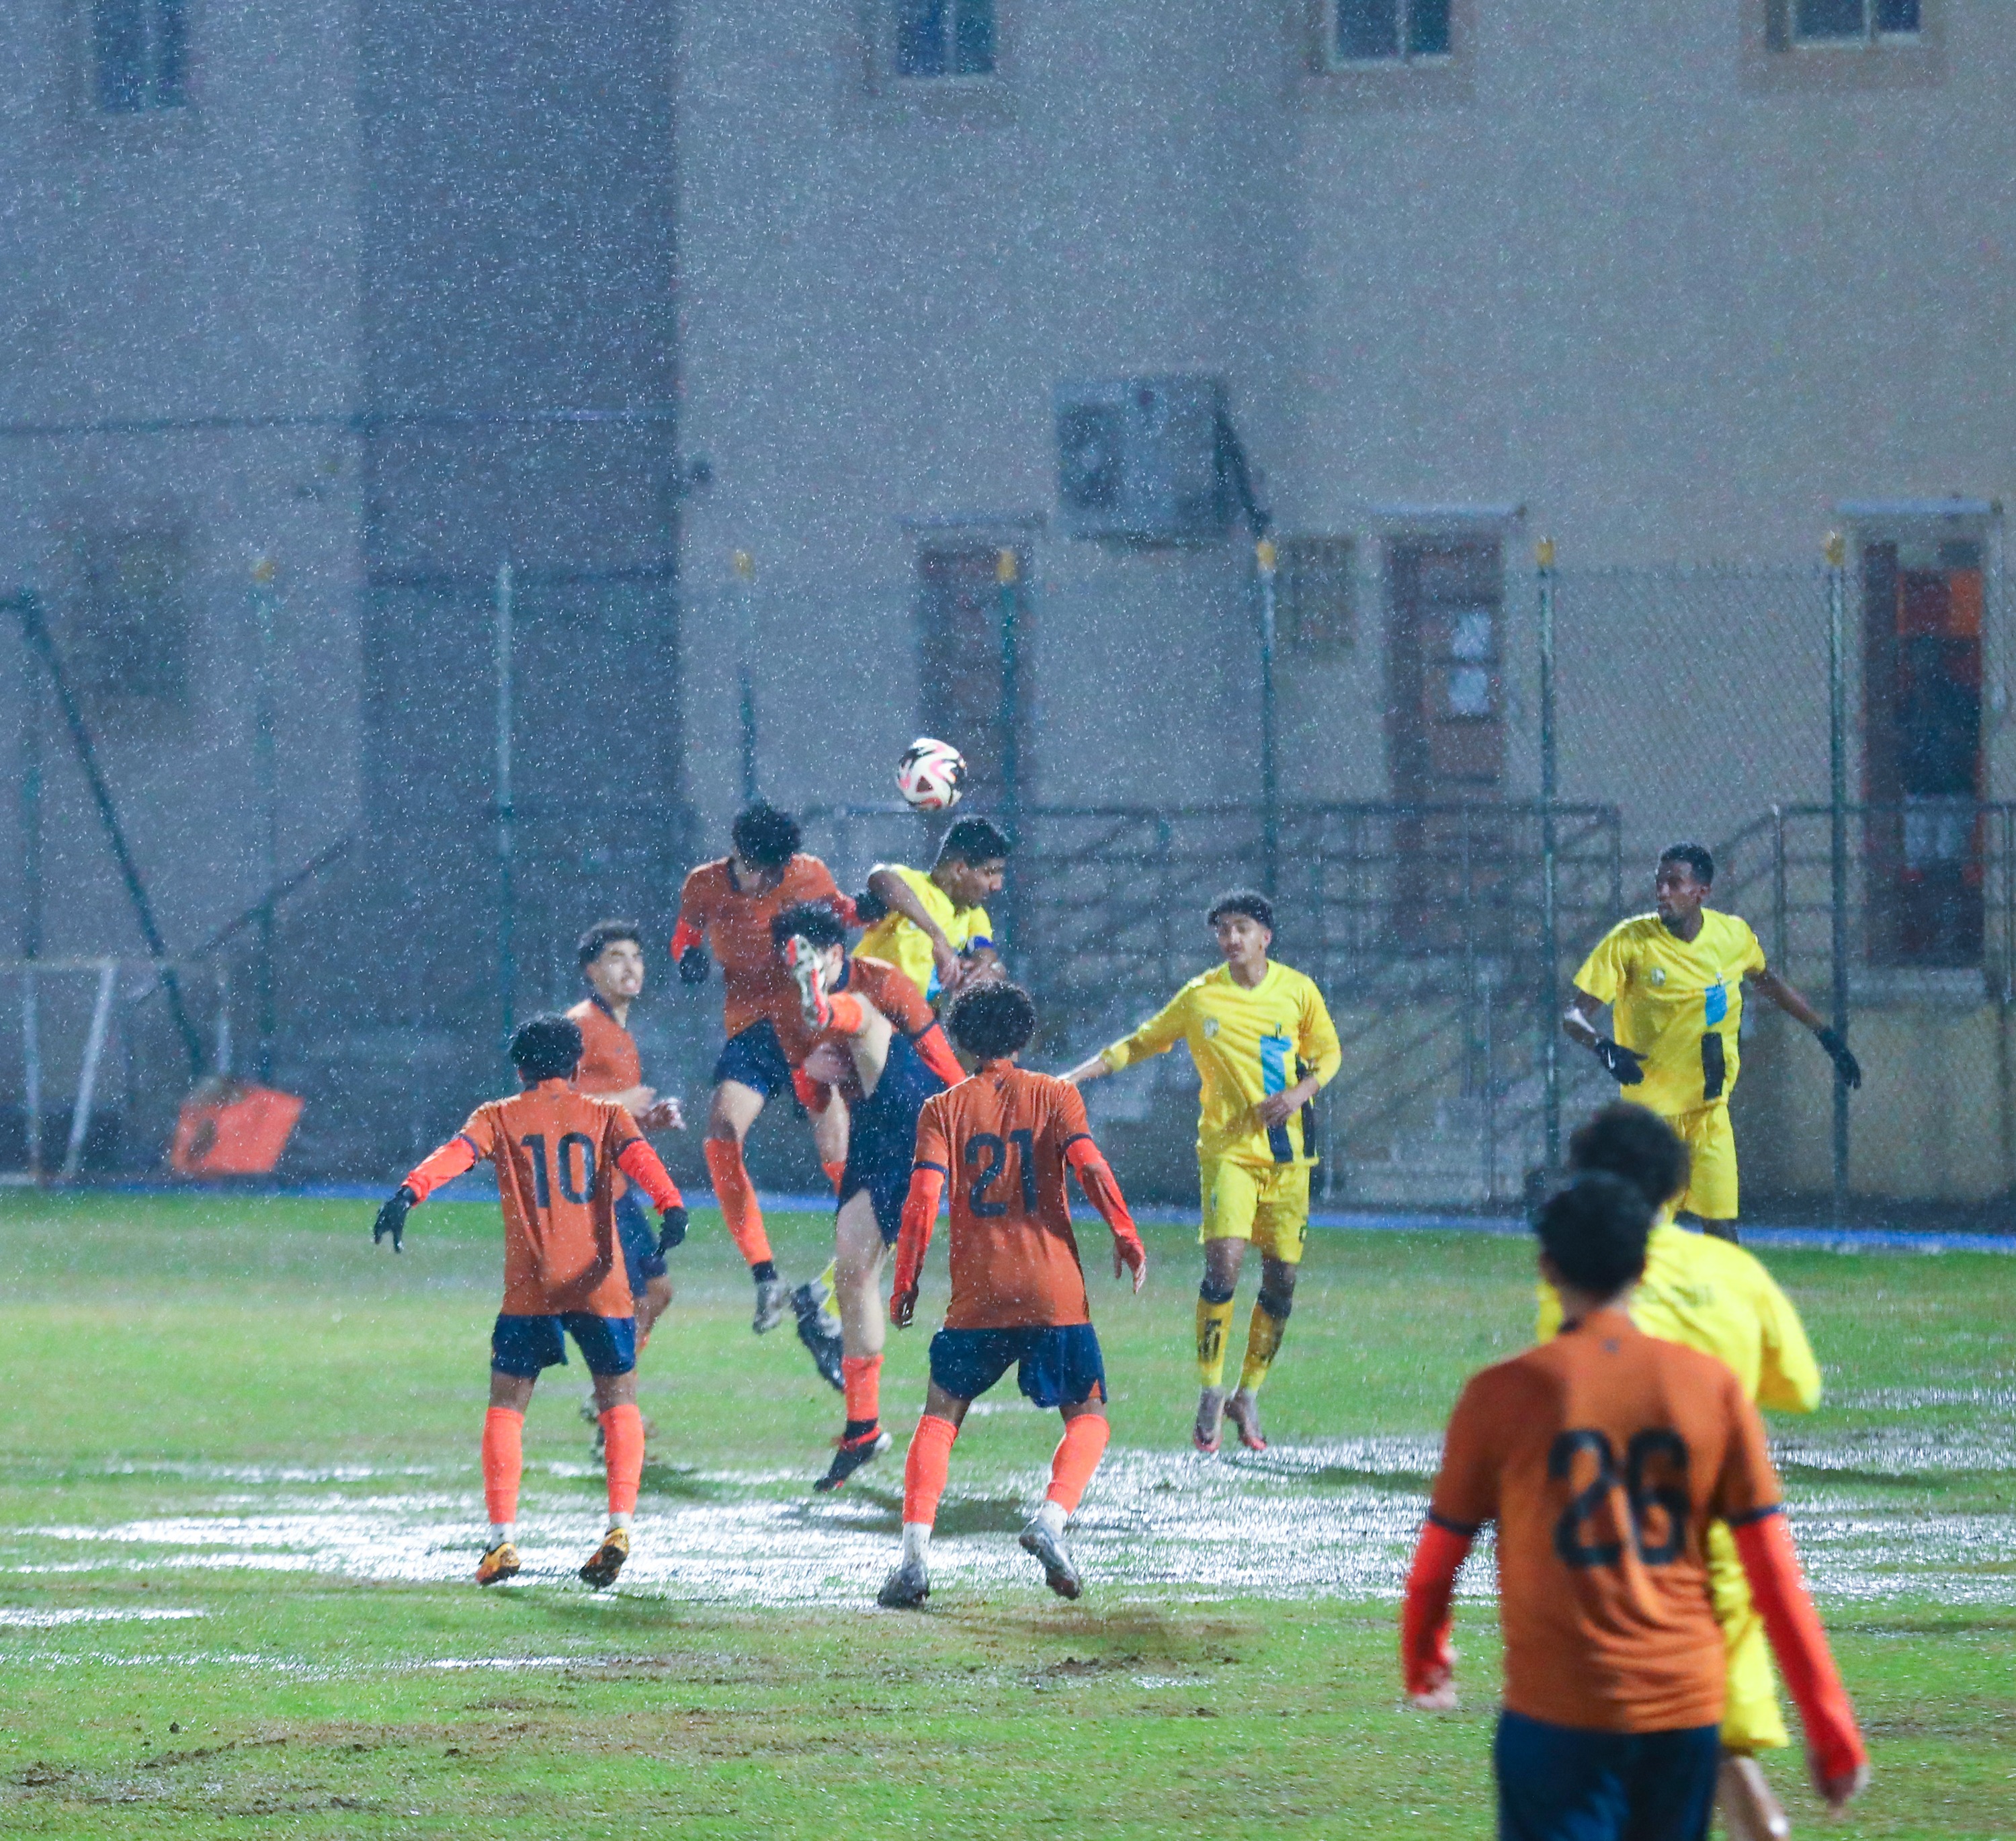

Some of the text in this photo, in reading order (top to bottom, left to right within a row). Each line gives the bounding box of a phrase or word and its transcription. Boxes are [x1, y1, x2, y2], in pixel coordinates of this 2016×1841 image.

[521, 1131, 596, 1207] 10
[965, 1128, 1038, 1218] 21
[1548, 1427, 1690, 1570] 26
